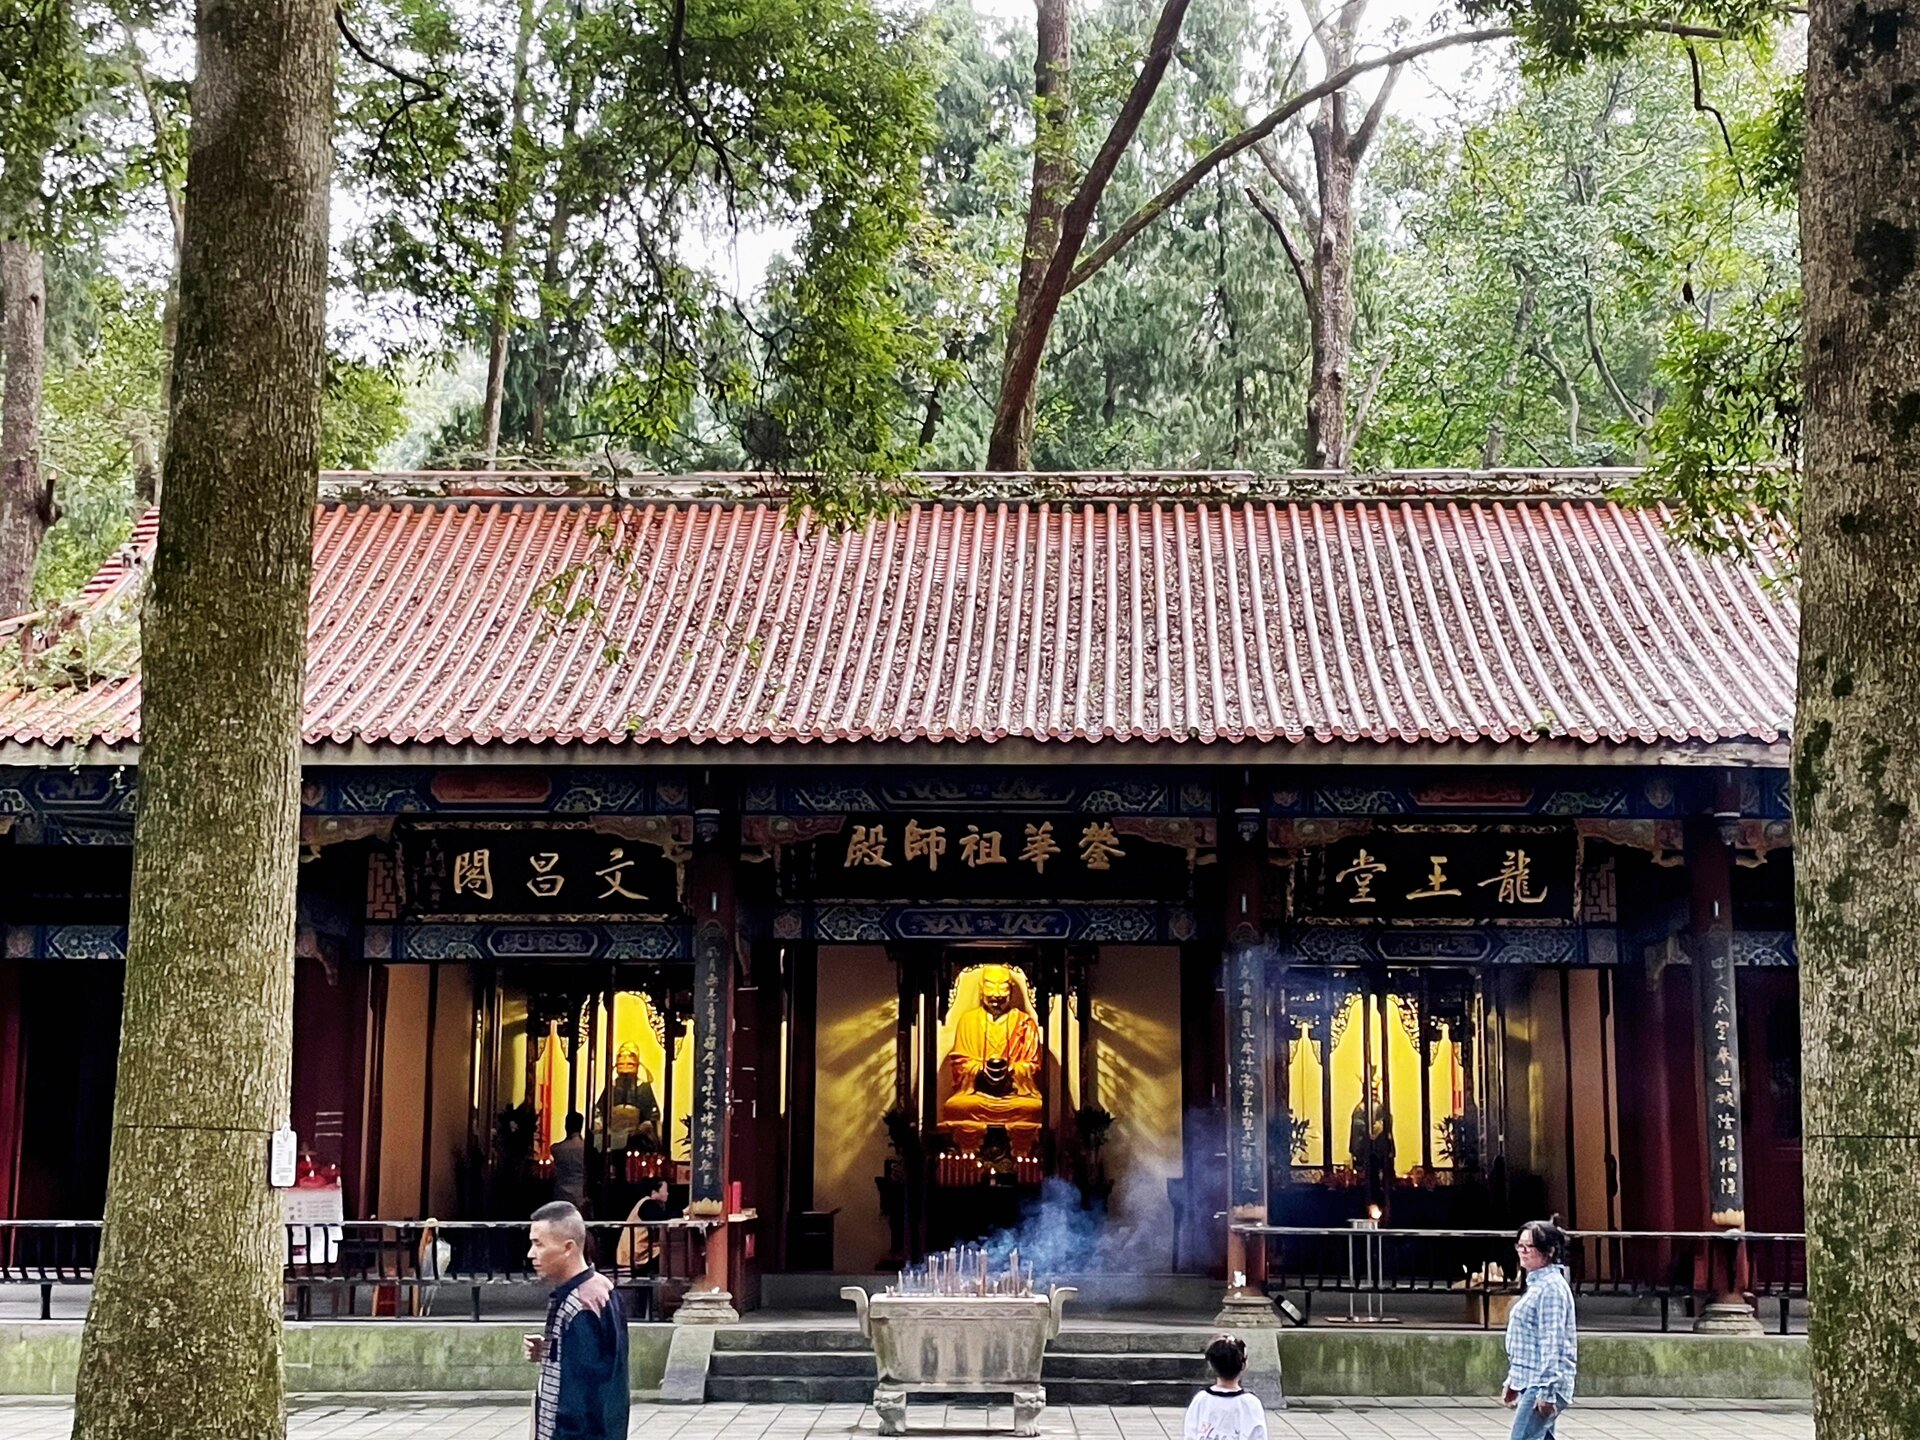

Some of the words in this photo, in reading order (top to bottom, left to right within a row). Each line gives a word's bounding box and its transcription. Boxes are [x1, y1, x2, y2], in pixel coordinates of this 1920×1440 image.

[453, 847, 650, 901] 文昌閣
[1335, 848, 1549, 904] 龍王堂
